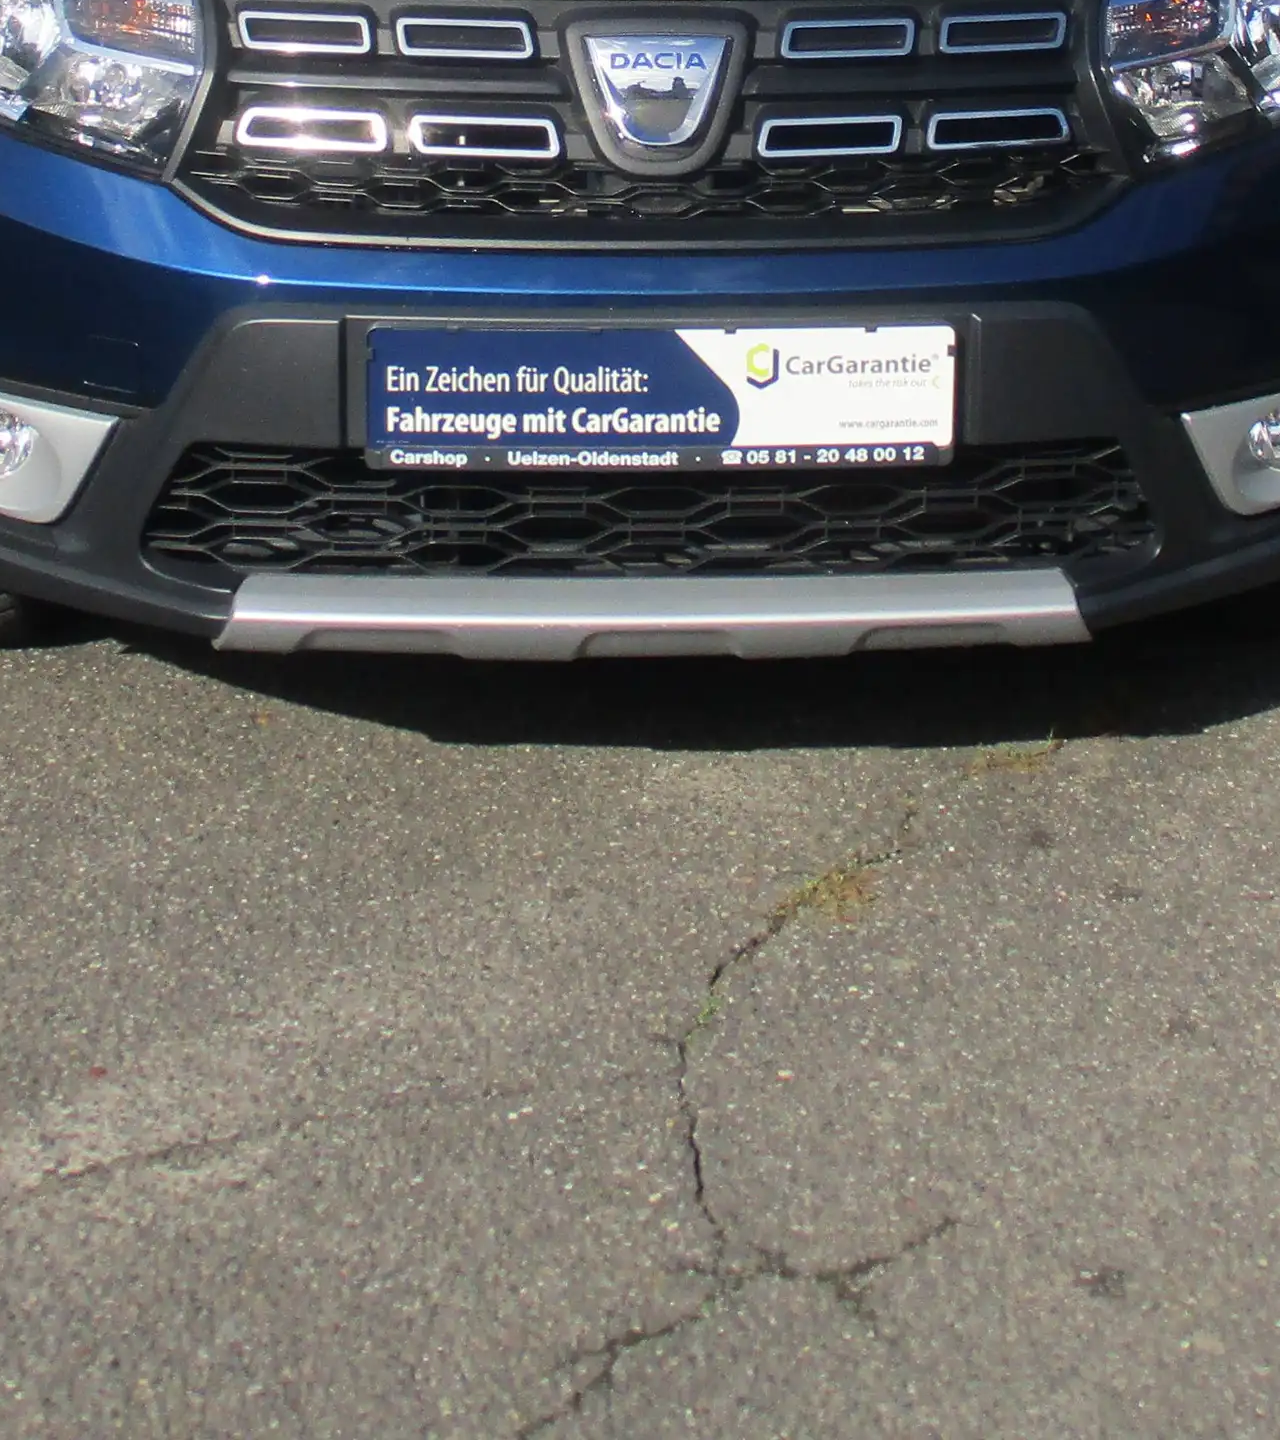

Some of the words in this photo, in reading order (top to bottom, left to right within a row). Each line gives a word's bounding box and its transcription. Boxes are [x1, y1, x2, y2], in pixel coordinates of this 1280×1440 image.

[610, 52, 707, 70] DACIA
[386, 365, 419, 392] Ein
[425, 365, 510, 392] Zeichen
[516, 365, 549, 392] für
[553, 365, 649, 395] Qualität:
[848, 378, 872, 389] takes
[875, 375, 890, 388] the
[910, 378, 927, 388] out
[386, 406, 517, 440] Fahrzeuge
[522, 406, 567, 433] mit
[572, 406, 721, 433] CarGarantie
[838, 419, 939, 430] www.cargarantie.com
[390, 448, 468, 468] Carshop
[507, 450, 680, 466] Uelzen-Oldenstadt
[746, 450, 771, 465] 05
[774, 449, 796, 464] 81
[816, 448, 840, 463] 20
[844, 448, 869, 462] 48
[873, 447, 897, 462] 00
[903, 446, 925, 461] 12
